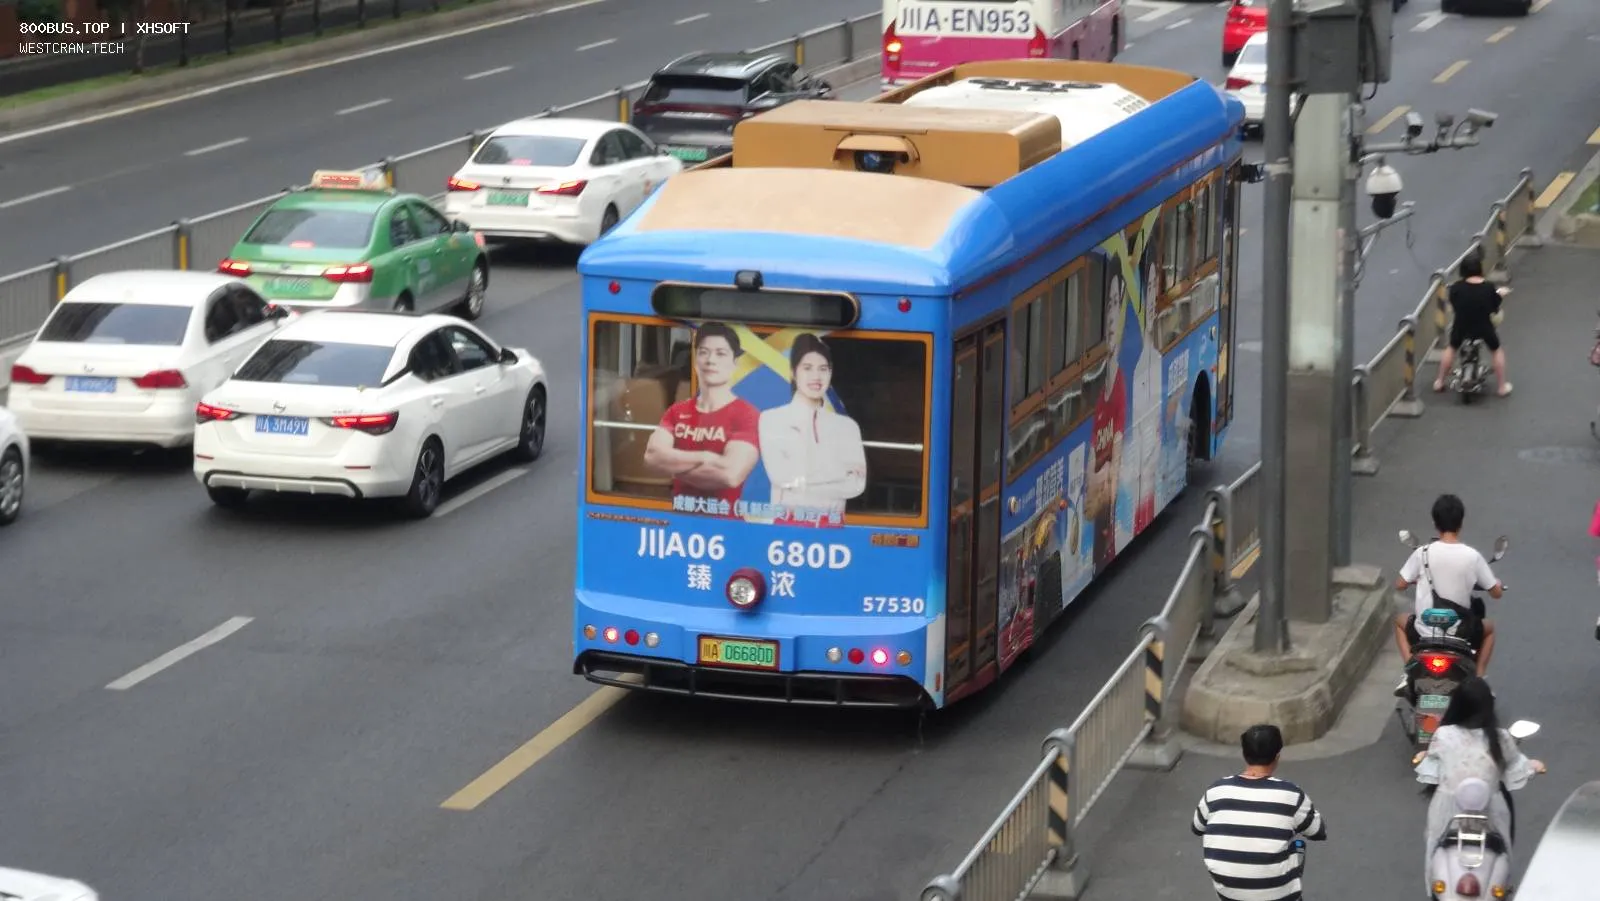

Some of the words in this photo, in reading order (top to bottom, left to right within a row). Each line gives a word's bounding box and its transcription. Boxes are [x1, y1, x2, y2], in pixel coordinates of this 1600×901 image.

[674, 423, 726, 442] CHINA
[637, 527, 726, 560] 川A06
[767, 540, 852, 571] 680D
[687, 563, 712, 591] 臻
[770, 570, 795, 598] 浓
[863, 596, 925, 614] 57530
